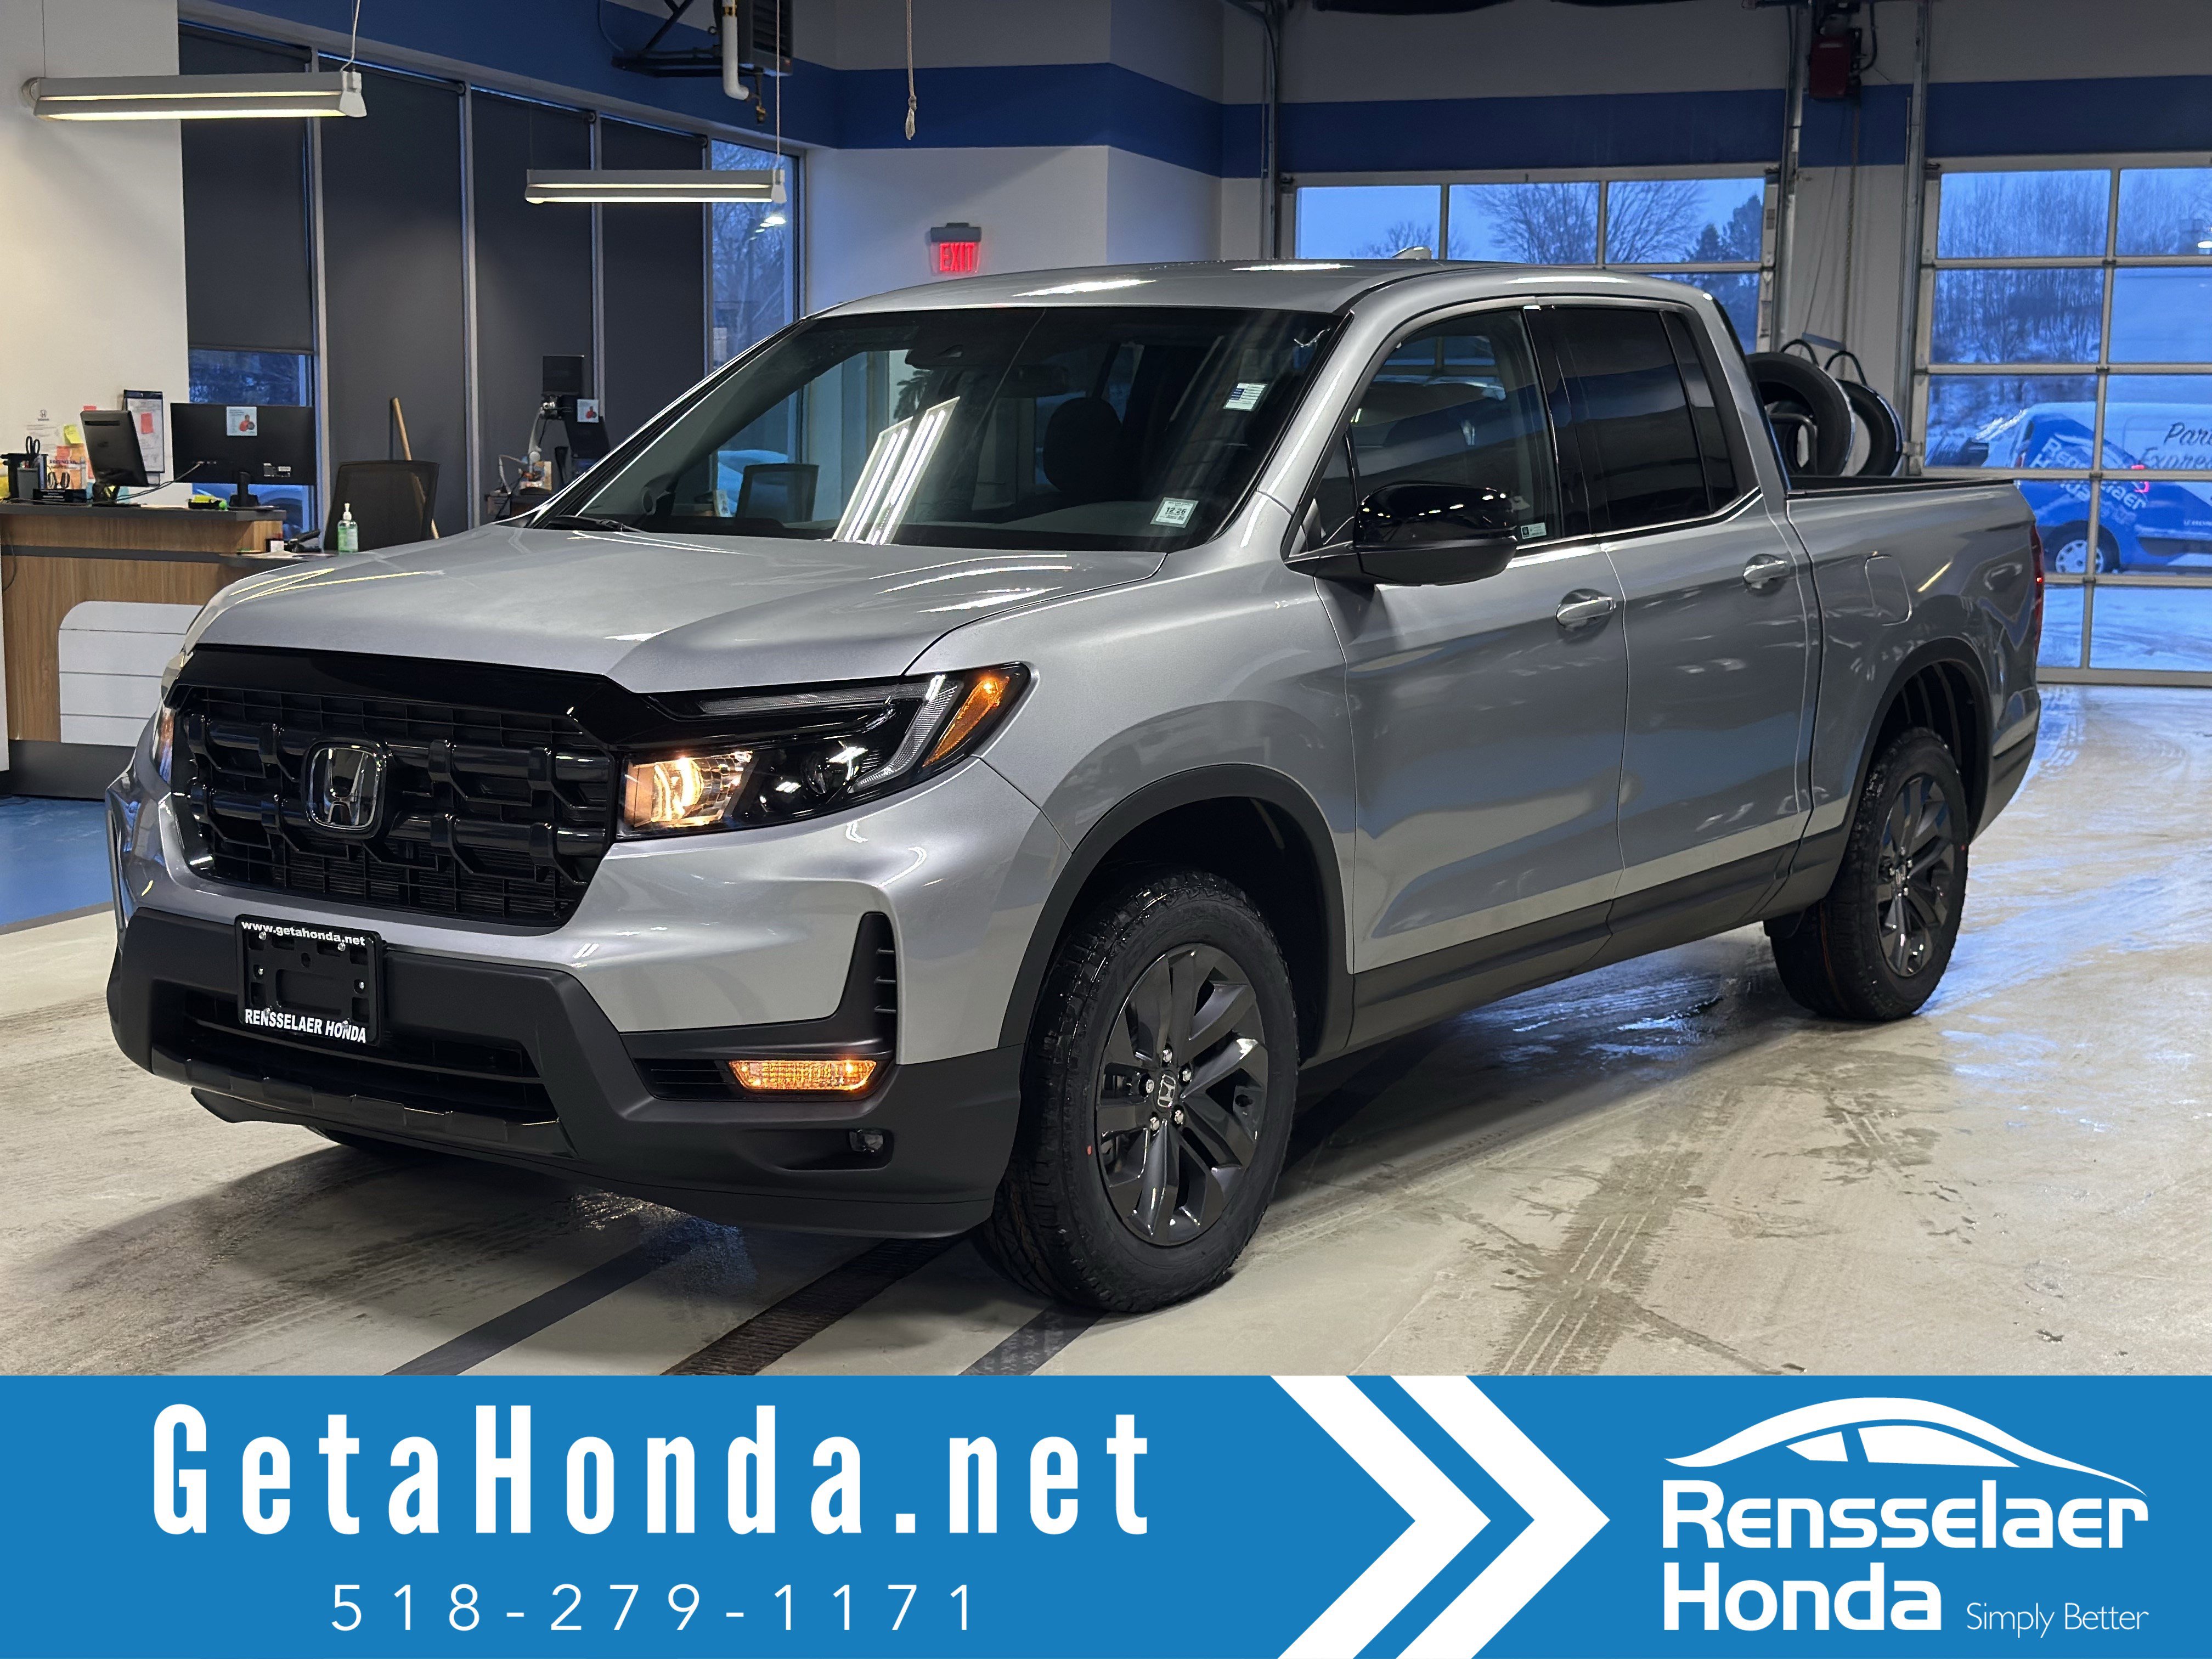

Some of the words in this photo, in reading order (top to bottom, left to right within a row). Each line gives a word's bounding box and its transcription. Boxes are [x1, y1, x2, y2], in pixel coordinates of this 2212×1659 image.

[940, 242, 974, 271] EXIT
[241, 921, 365, 946] www.getahonda.net
[245, 1009, 322, 1034] RENSSELAER
[325, 1020, 366, 1043] HONDA
